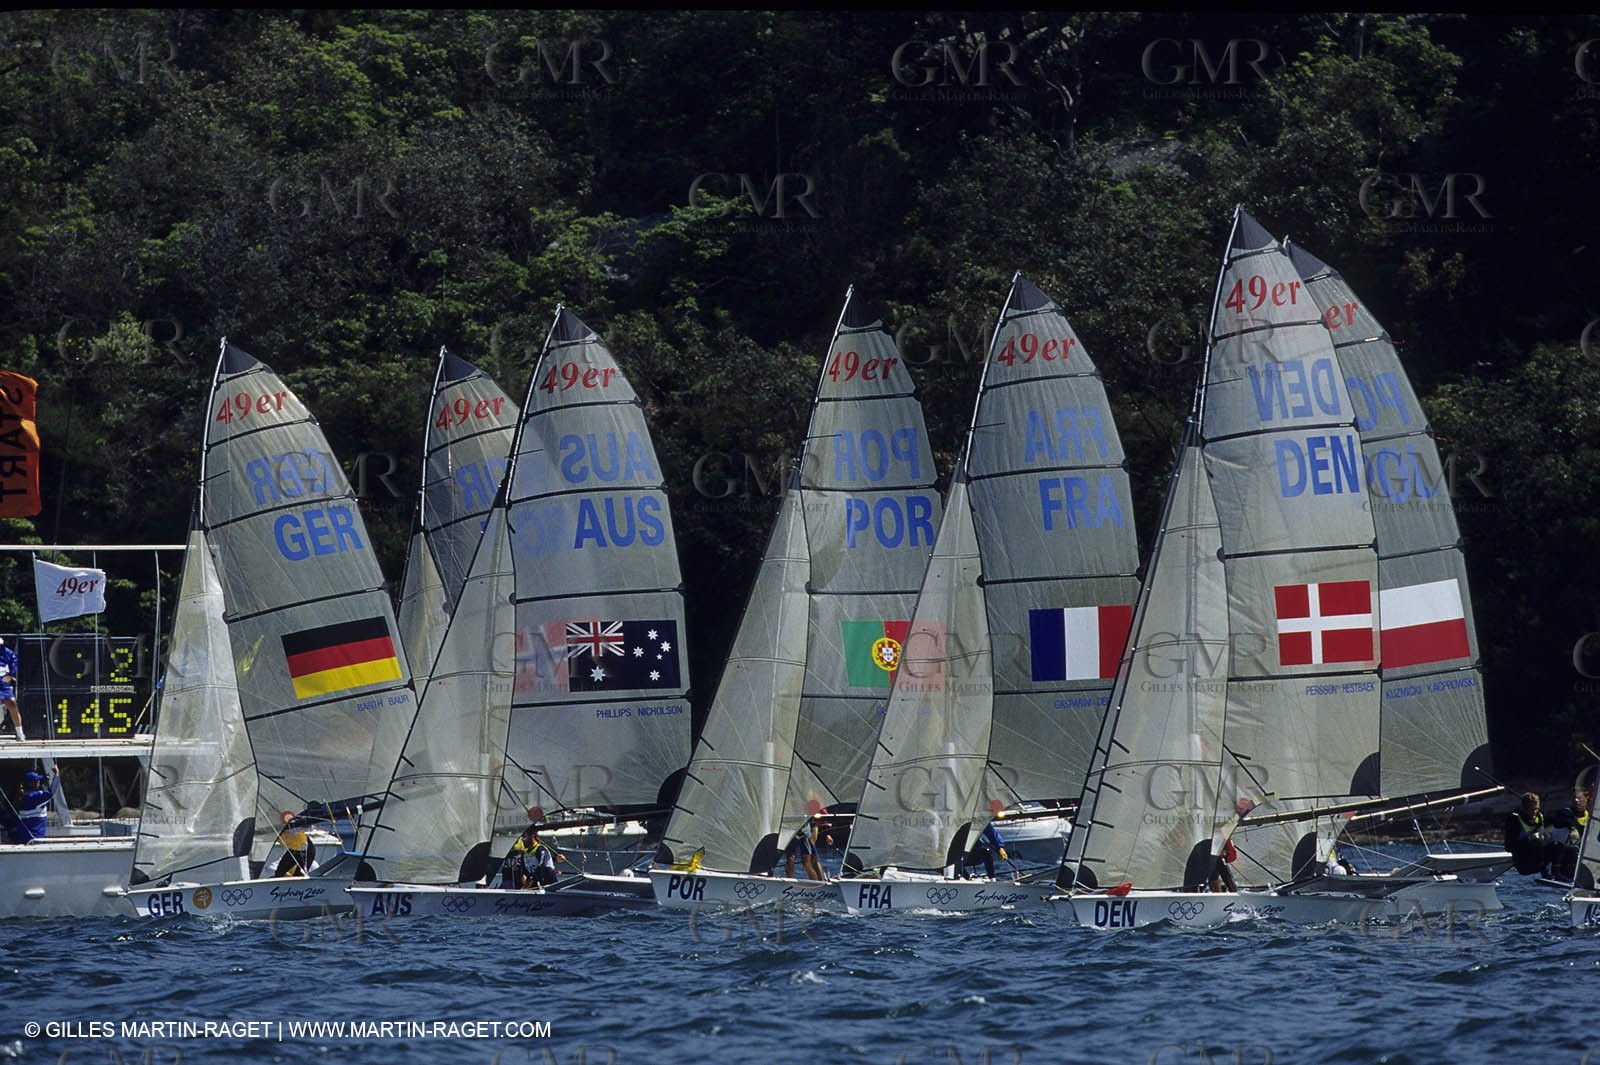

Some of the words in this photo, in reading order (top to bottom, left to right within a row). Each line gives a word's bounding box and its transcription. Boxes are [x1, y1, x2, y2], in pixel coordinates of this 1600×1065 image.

[1224, 274, 1301, 314] 49er
[1324, 300, 1360, 330] er
[997, 333, 1076, 367] 49er
[540, 362, 616, 394] 49er
[828, 352, 898, 382] 49er
[216, 390, 287, 424] 49er
[436, 396, 505, 430] 49er
[1273, 434, 1360, 498] DEN
[1038, 476, 1125, 531] FRA
[274, 505, 364, 562] GER
[574, 496, 665, 549] AUS
[846, 496, 934, 549] POR
[56, 577, 98, 596] 49er
[57, 698, 132, 733] 145
[596, 708, 632, 718] PHILLIPS
[638, 705, 683, 716] NICHOLSON
[270, 886, 305, 902] Sydney
[303, 888, 326, 900] 2000
[668, 875, 707, 900] POR
[782, 886, 817, 900] Sydney
[814, 890, 838, 900] 2000
[858, 884, 892, 909] FRA
[974, 890, 1009, 905] Sydney
[1006, 894, 1029, 904] 2000
[148, 892, 184, 918] GER
[372, 892, 413, 916] AUS
[1094, 900, 1138, 928] DEN
